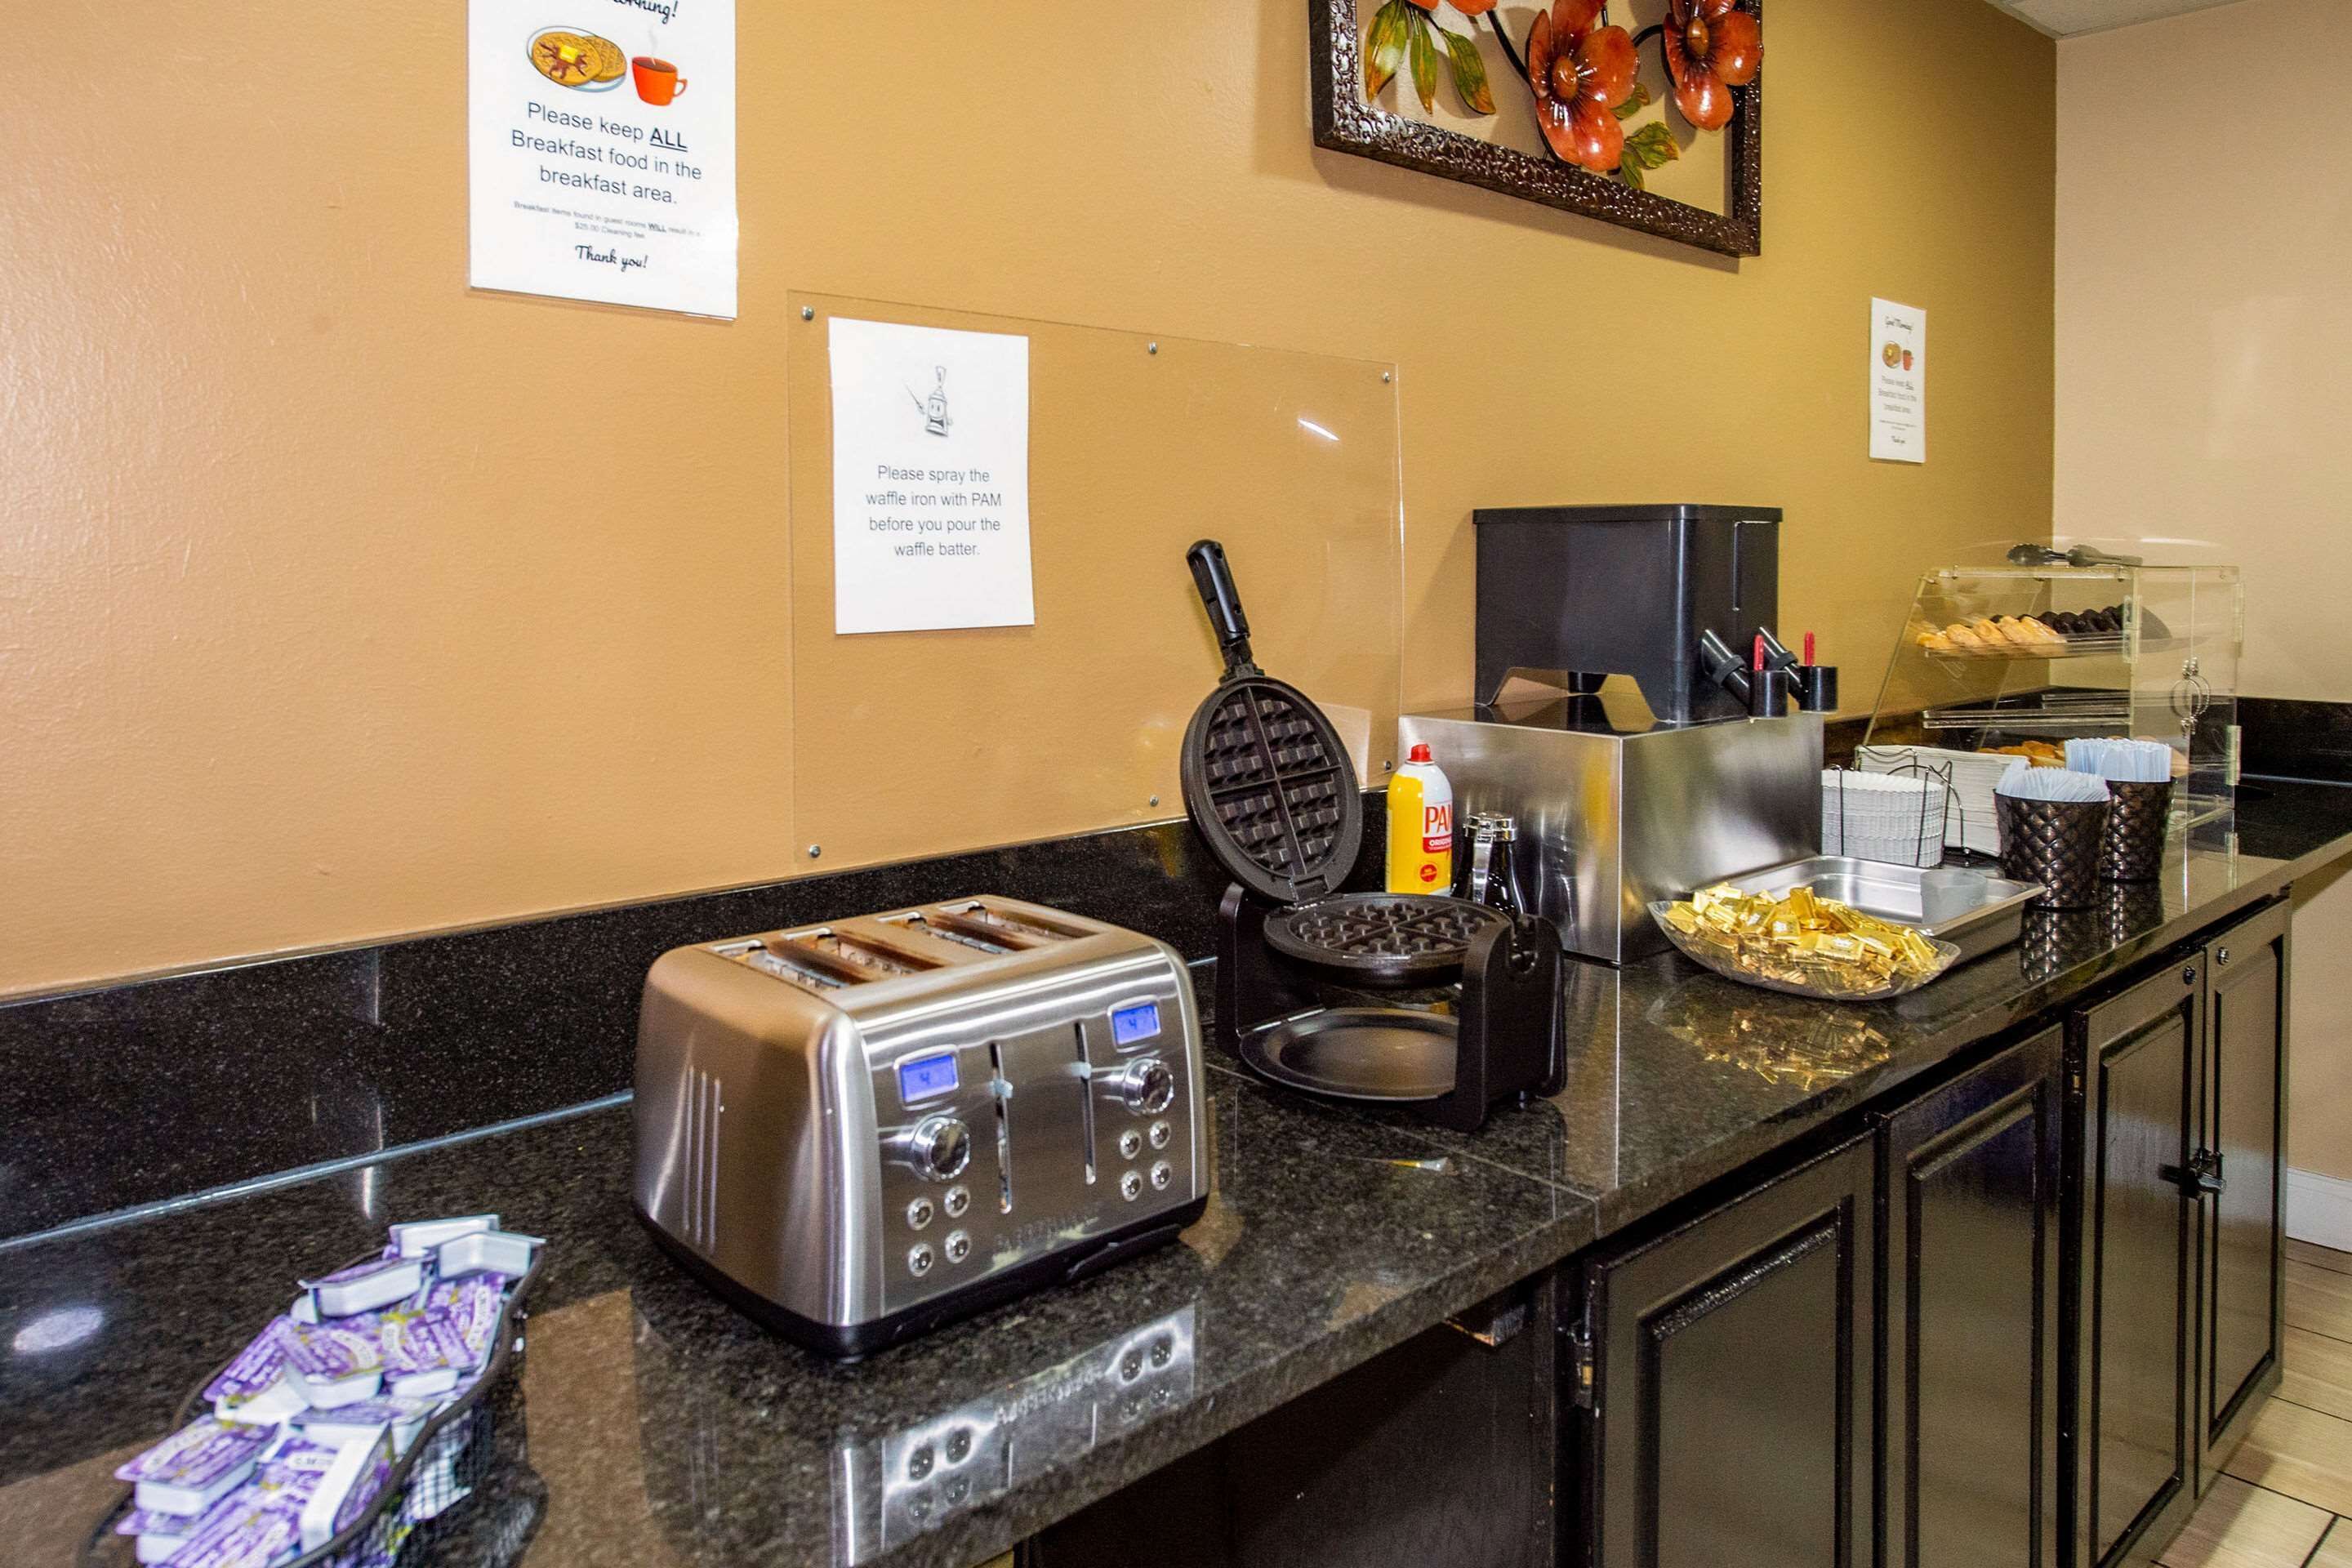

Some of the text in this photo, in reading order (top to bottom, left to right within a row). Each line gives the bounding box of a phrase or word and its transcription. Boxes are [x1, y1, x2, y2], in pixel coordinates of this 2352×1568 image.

[527, 101, 688, 152] Please keep ALL
[511, 129, 702, 180] Breakfast food in the
[540, 165, 678, 204] breakfast area.
[575, 245, 648, 272] Thank you!
[877, 465, 990, 485] Please spray the
[866, 491, 1002, 506] waffle iron with PAM
[869, 516, 1000, 535] before you pour the
[894, 541, 981, 556] waffle batter.
